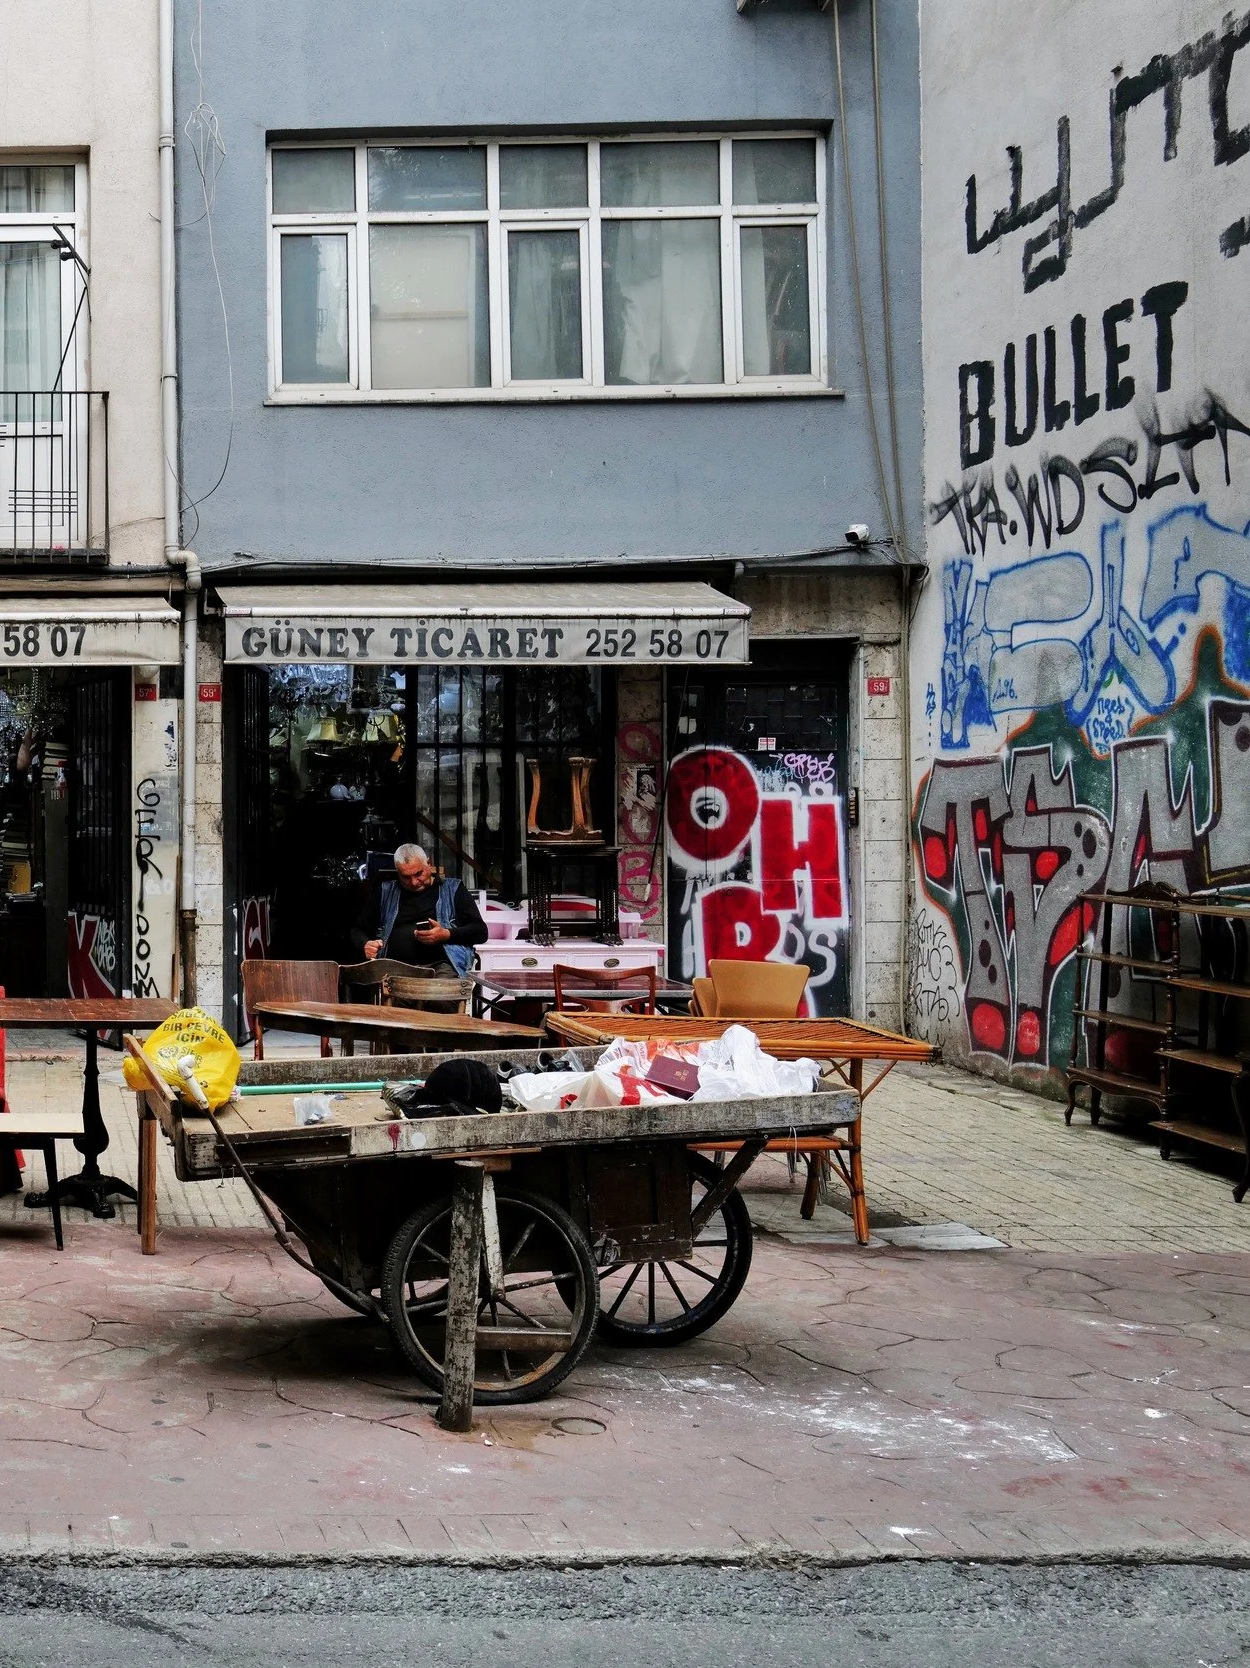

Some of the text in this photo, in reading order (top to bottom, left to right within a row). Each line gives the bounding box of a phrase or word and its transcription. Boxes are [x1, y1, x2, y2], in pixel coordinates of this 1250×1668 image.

[958, 280, 1189, 470] BULLET
[3, 625, 40, 657] 58
[50, 625, 86, 657] 07
[241, 619, 729, 658] GÜNEY TİCARET 252 58 07
